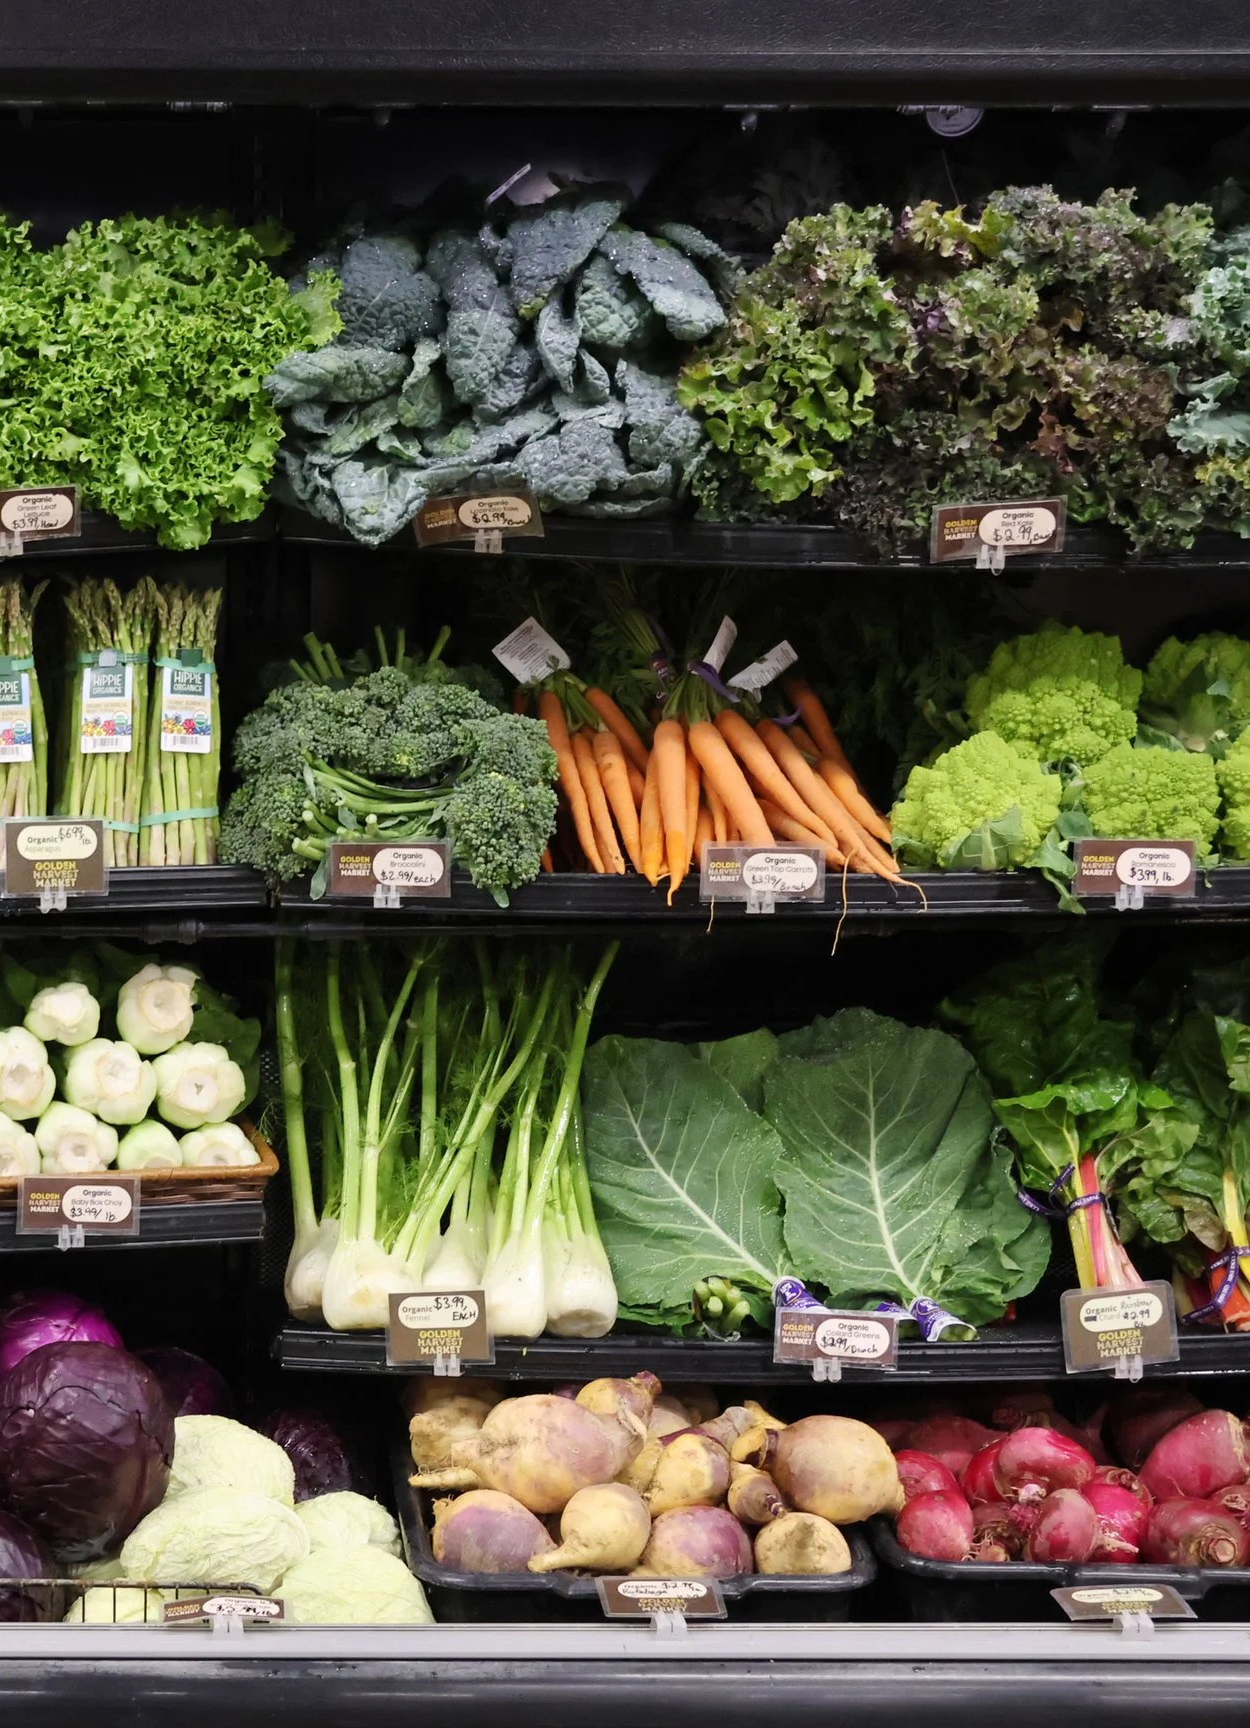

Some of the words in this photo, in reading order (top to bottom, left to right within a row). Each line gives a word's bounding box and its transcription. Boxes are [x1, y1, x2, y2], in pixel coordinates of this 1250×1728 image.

[23, 496, 52, 505] Organic
[478, 500, 509, 508] Organic
[1002, 512, 1034, 521] Organic
[945, 519, 977, 528] GOLDEN
[944, 526, 979, 534] HARVEST
[945, 532, 976, 541] MARKET
[393, 852, 423, 860] Organic
[1139, 852, 1170, 861] Organic
[765, 857, 796, 865] Organic
[35, 862, 76, 871] GOLDEN
[771, 865, 784, 873] Top
[786, 865, 814, 873] Carrots
[33, 870, 79, 879] HARVEST
[35, 878, 76, 887] MARKET
[83, 1189, 112, 1197] Organic
[104, 1199, 123, 1207] Choy
[1085, 1305, 1117, 1314] Organic
[782, 1324, 814, 1332] GOLDEN
[838, 1322, 869, 1331] Organic
[419, 1330, 461, 1339] GOLDEN
[782, 1331, 814, 1339] HARVEST
[1098, 1329, 1141, 1341] GOLDEN
[418, 1338, 464, 1346] HARVEST
[782, 1337, 812, 1345] MARKET
[1097, 1337, 1144, 1350] HARVEST
[421, 1346, 461, 1355] MARKET
[1100, 1346, 1143, 1358] MARKET
